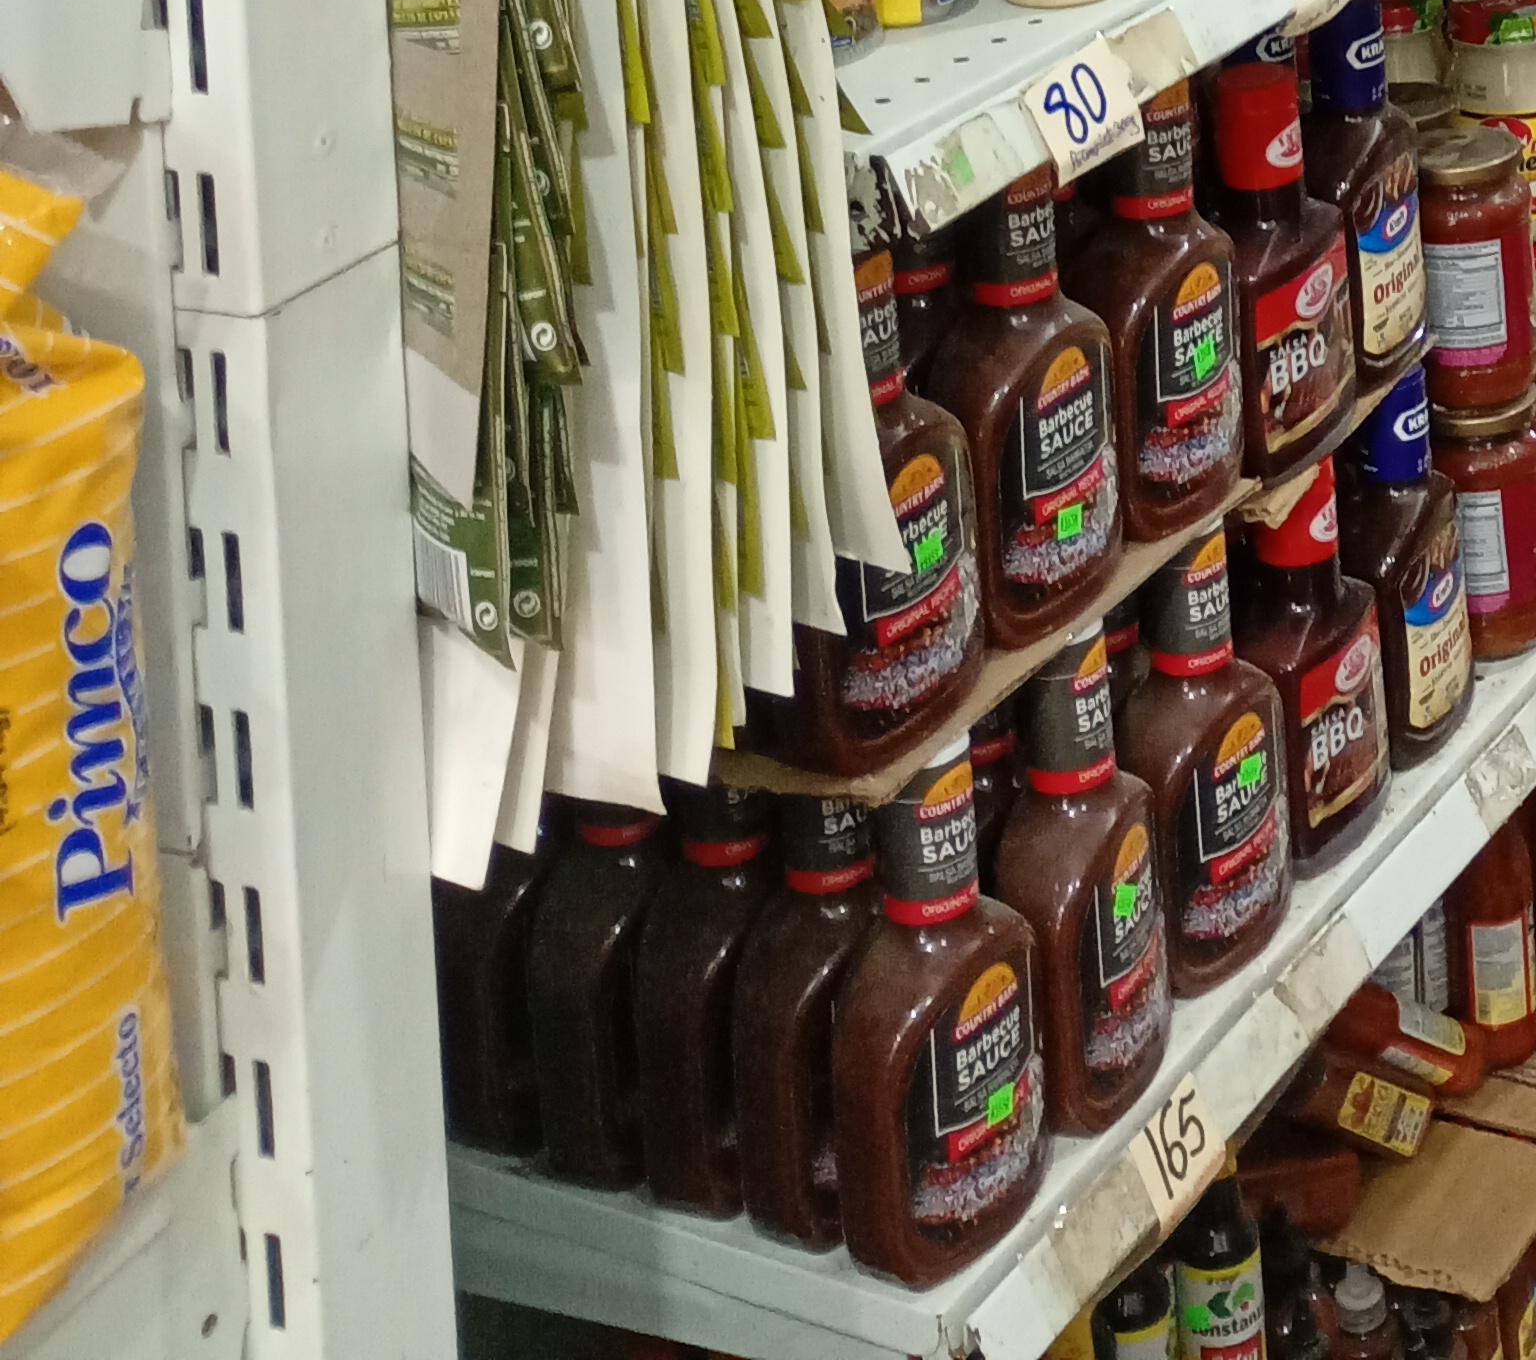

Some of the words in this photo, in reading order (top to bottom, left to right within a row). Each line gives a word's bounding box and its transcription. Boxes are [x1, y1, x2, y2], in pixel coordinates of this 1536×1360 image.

[1044, 63, 1107, 145] 80
[1269, 332, 1308, 362] SALSA
[1270, 333, 1328, 396] BBQ
[1037, 389, 1094, 437] Barbecue
[1040, 411, 1095, 461] SAUCE
[1418, 611, 1467, 679] Original
[56, 518, 134, 923] Pimco
[1311, 705, 1365, 772] BBQ
[955, 1003, 1021, 1070] Barbecue
[957, 1028, 1021, 1092] SAUCE
[119, 1005, 141, 1173] Selecto
[1143, 1088, 1206, 1200] 165
